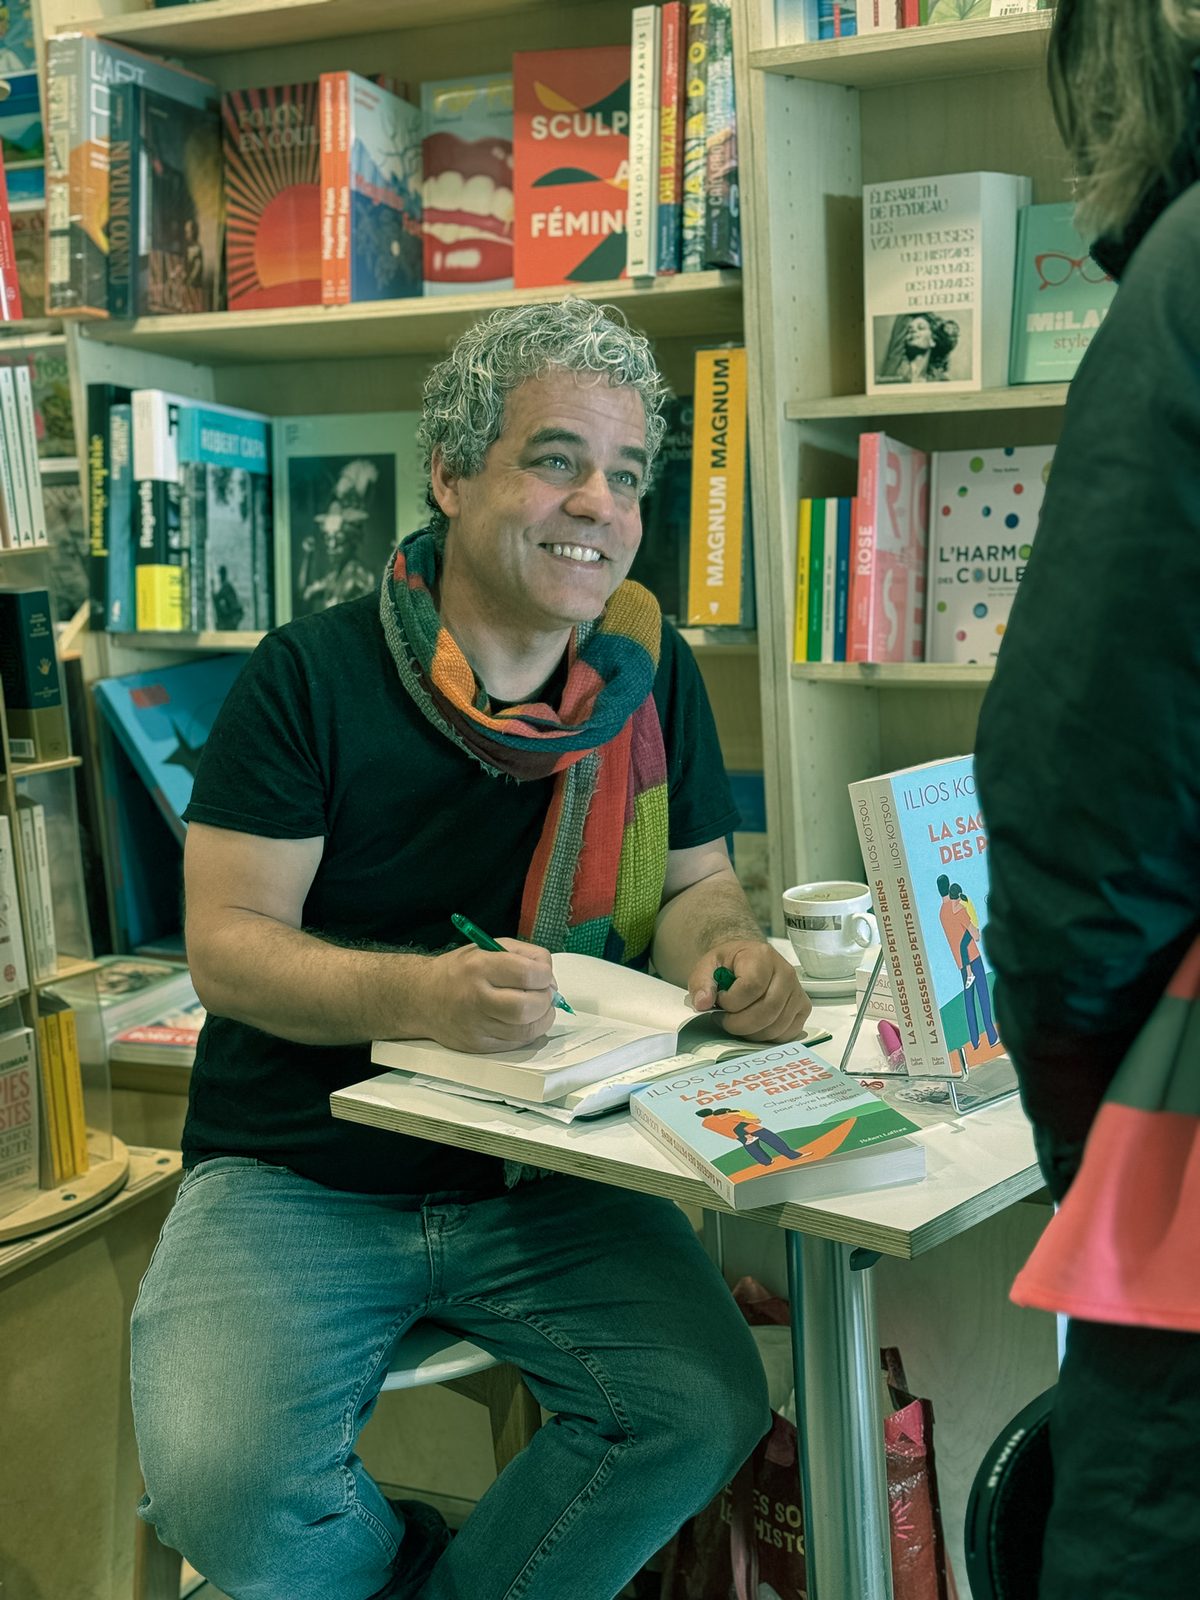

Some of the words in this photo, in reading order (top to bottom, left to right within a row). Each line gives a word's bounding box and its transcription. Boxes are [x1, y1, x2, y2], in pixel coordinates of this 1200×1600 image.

[91, 50, 146, 86] L'ART
[636, 31, 647, 109] DISPARUS
[239, 103, 306, 130] FOLON
[684, 3, 707, 228] VALADON
[239, 130, 266, 152] EN
[110, 162, 130, 193] VU
[870, 184, 939, 205] ÉLISABETH
[870, 205, 887, 220] DE
[889, 199, 949, 218] FEYDEAU
[870, 221, 893, 236] LES
[870, 228, 975, 251] VOLUPTUEUSES
[905, 281, 926, 292] DES
[928, 277, 975, 291] FEMMES
[908, 295, 922, 307] DE
[1054, 333, 1090, 353] style
[710, 357, 730, 469] MAGNUM
[706, 475, 727, 587] MAGNUM
[857, 525, 874, 577] ROSE
[937, 577, 953, 585] DES
[904, 782, 950, 810] ILIOS
[857, 799, 876, 844] KOTSOU
[878, 795, 897, 841] KOTSOU
[928, 820, 954, 843] LA
[867, 844, 881, 873] ILIOS
[889, 842, 902, 870] ILIOS
[939, 839, 974, 865] DES
[875, 879, 891, 913] RIENS
[896, 876, 912, 911] RIENS
[882, 914, 899, 953] PETITS
[903, 911, 920, 952] PETITS
[889, 954, 903, 977] DES
[911, 953, 925, 976] DES
[896, 978, 914, 1028] SAGESSE
[917, 977, 935, 1028] SAGESSE
[906, 1029, 918, 1046] LA
[928, 1029, 940, 1045] LA
[646, 1075, 705, 1098] ILIOS
[708, 1047, 801, 1079] KOTSOU
[680, 1089, 713, 1103] LA
[714, 1057, 816, 1090] SAGESSE
[695, 1088, 743, 1106] DES
[744, 1064, 825, 1092] PETITS
[763, 1071, 835, 1096] RIENS
[763, 1093, 802, 1109] Changer
[818, 1081, 847, 1094] regard
[772, 1103, 794, 1115] pour
[805, 1104, 818, 1112] du
[860, 1134, 884, 1144] Robert
